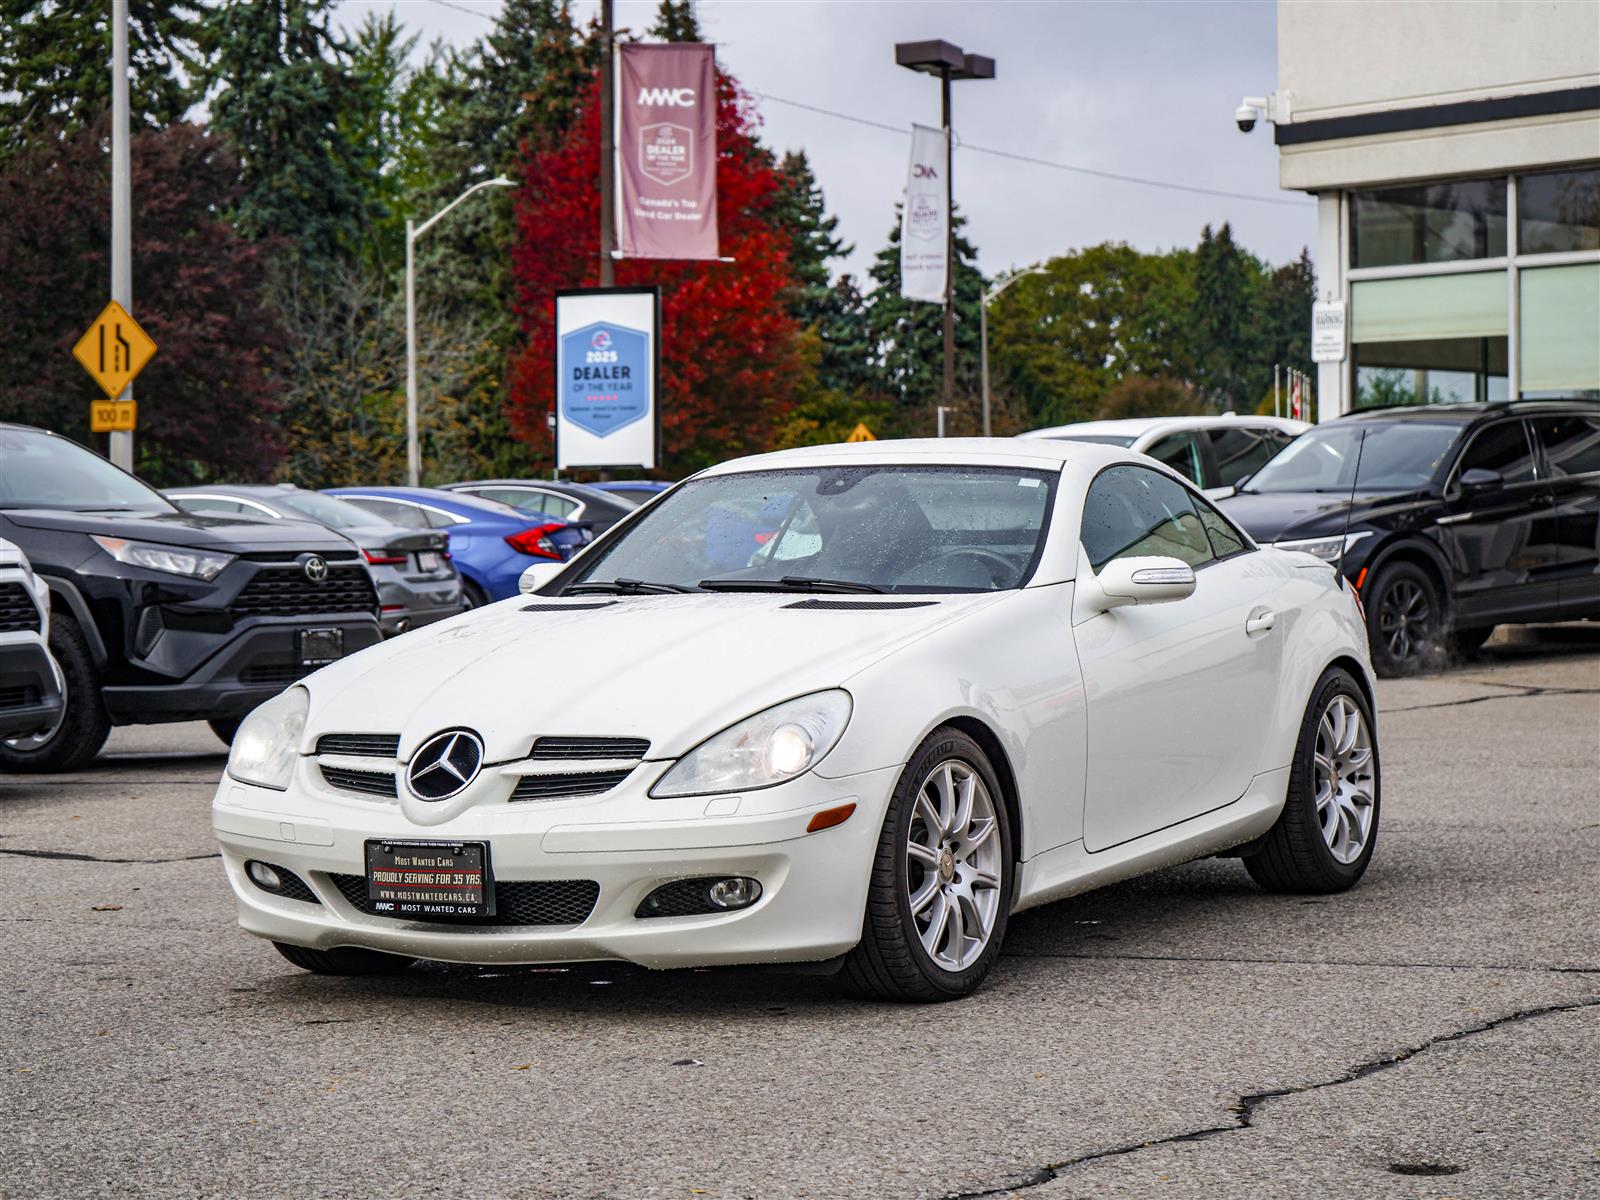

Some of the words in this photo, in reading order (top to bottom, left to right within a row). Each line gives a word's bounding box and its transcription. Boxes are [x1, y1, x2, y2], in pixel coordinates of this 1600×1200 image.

[638, 88, 695, 107] MWC
[646, 145, 685, 155] DEALER
[681, 199, 697, 209] Top
[674, 212, 703, 220] Dealer
[585, 351, 618, 363] 2025
[573, 366, 631, 380] DEALER
[573, 383, 584, 393] OF
[588, 383, 605, 392] THE
[608, 382, 633, 392] YEAR
[97, 408, 117, 422] 100
[373, 871, 403, 883] PROUDLY
[404, 872, 434, 884] SERVING
[435, 874, 451, 885] FOR
[453, 874, 464, 885] 35
[465, 874, 482, 885] YRS.
[375, 902, 394, 911] MWC
[401, 904, 420, 912] MOST
[424, 905, 454, 913] WANTED
[457, 906, 477, 914] CARS
